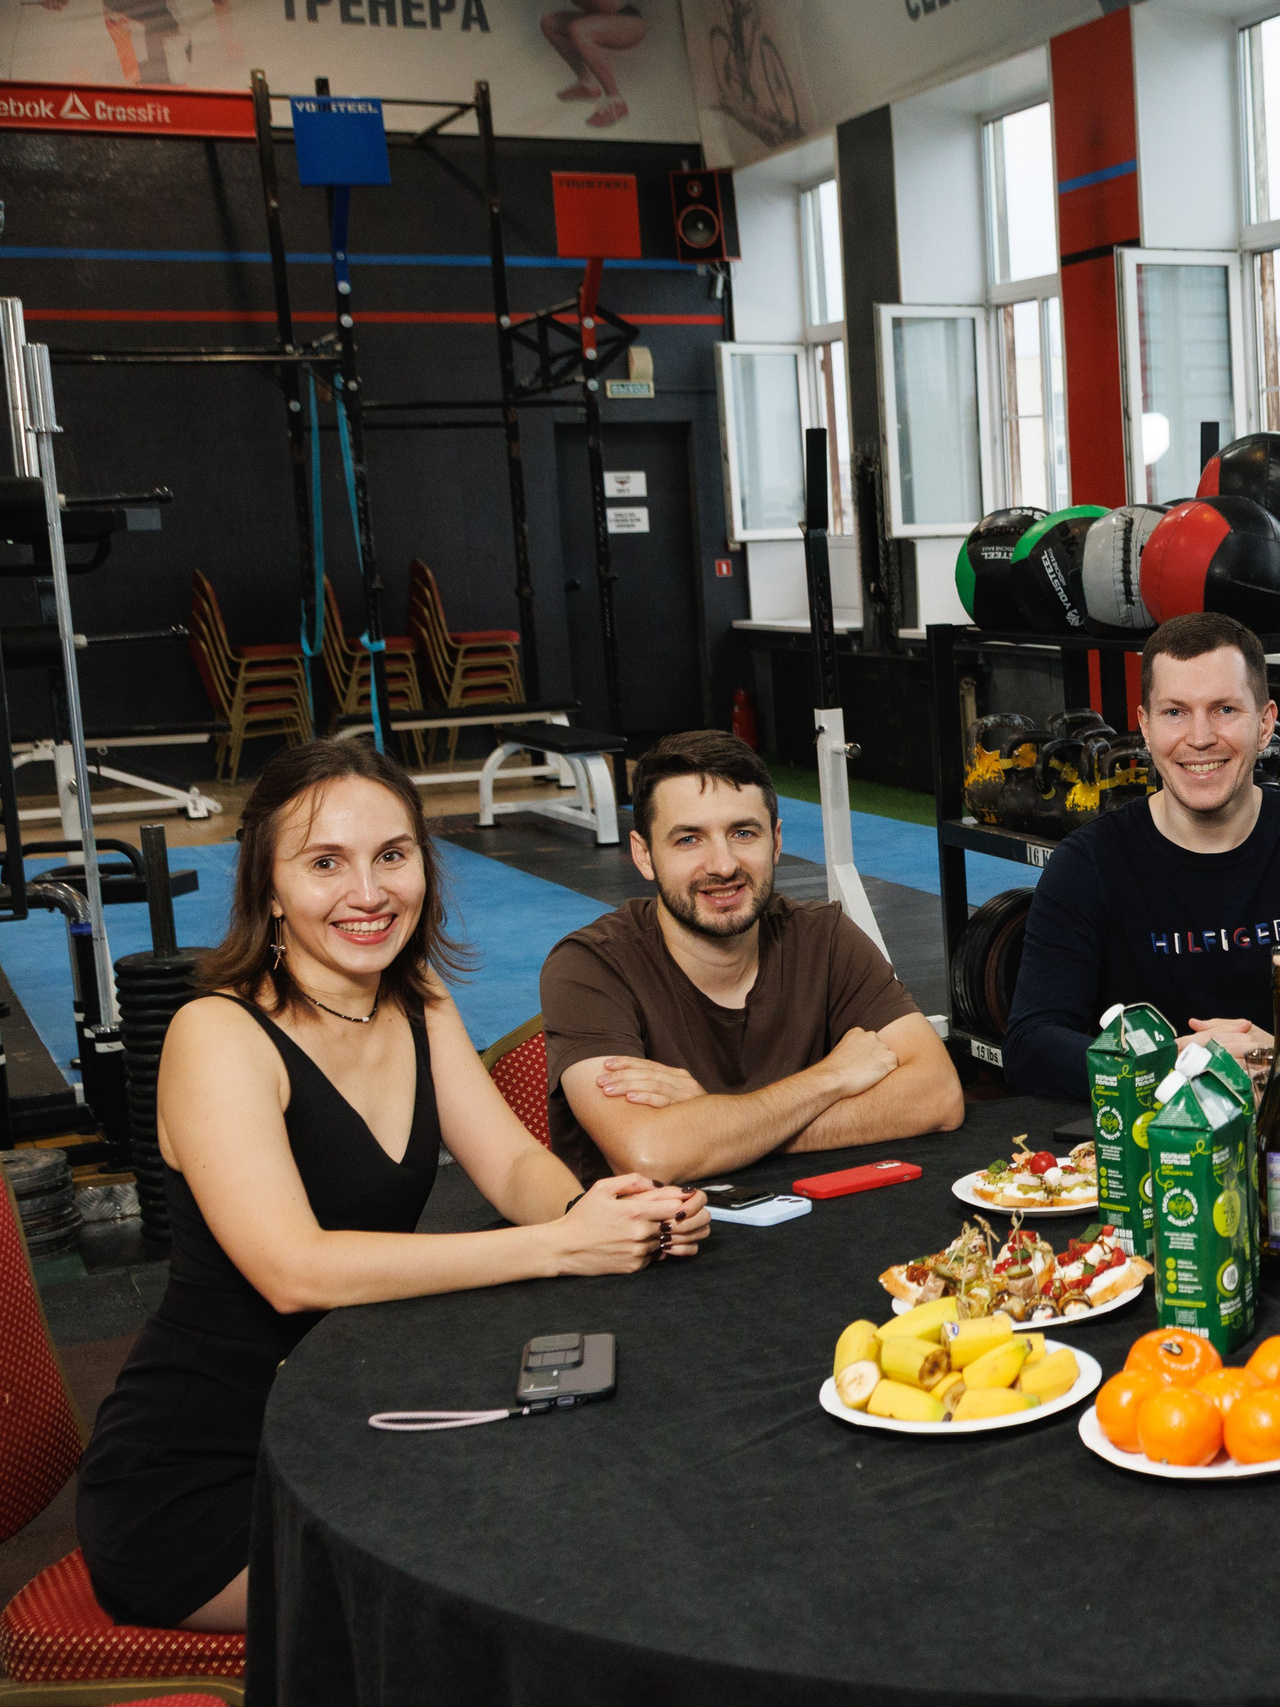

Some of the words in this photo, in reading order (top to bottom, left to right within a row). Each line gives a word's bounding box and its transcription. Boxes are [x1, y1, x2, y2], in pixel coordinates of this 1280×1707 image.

[94, 100, 171, 124] CrossFit
[1041, 550, 1072, 609] YOUSTEEL
[976, 1045, 986, 1059] 15
[986, 1048, 999, 1063] lbs
